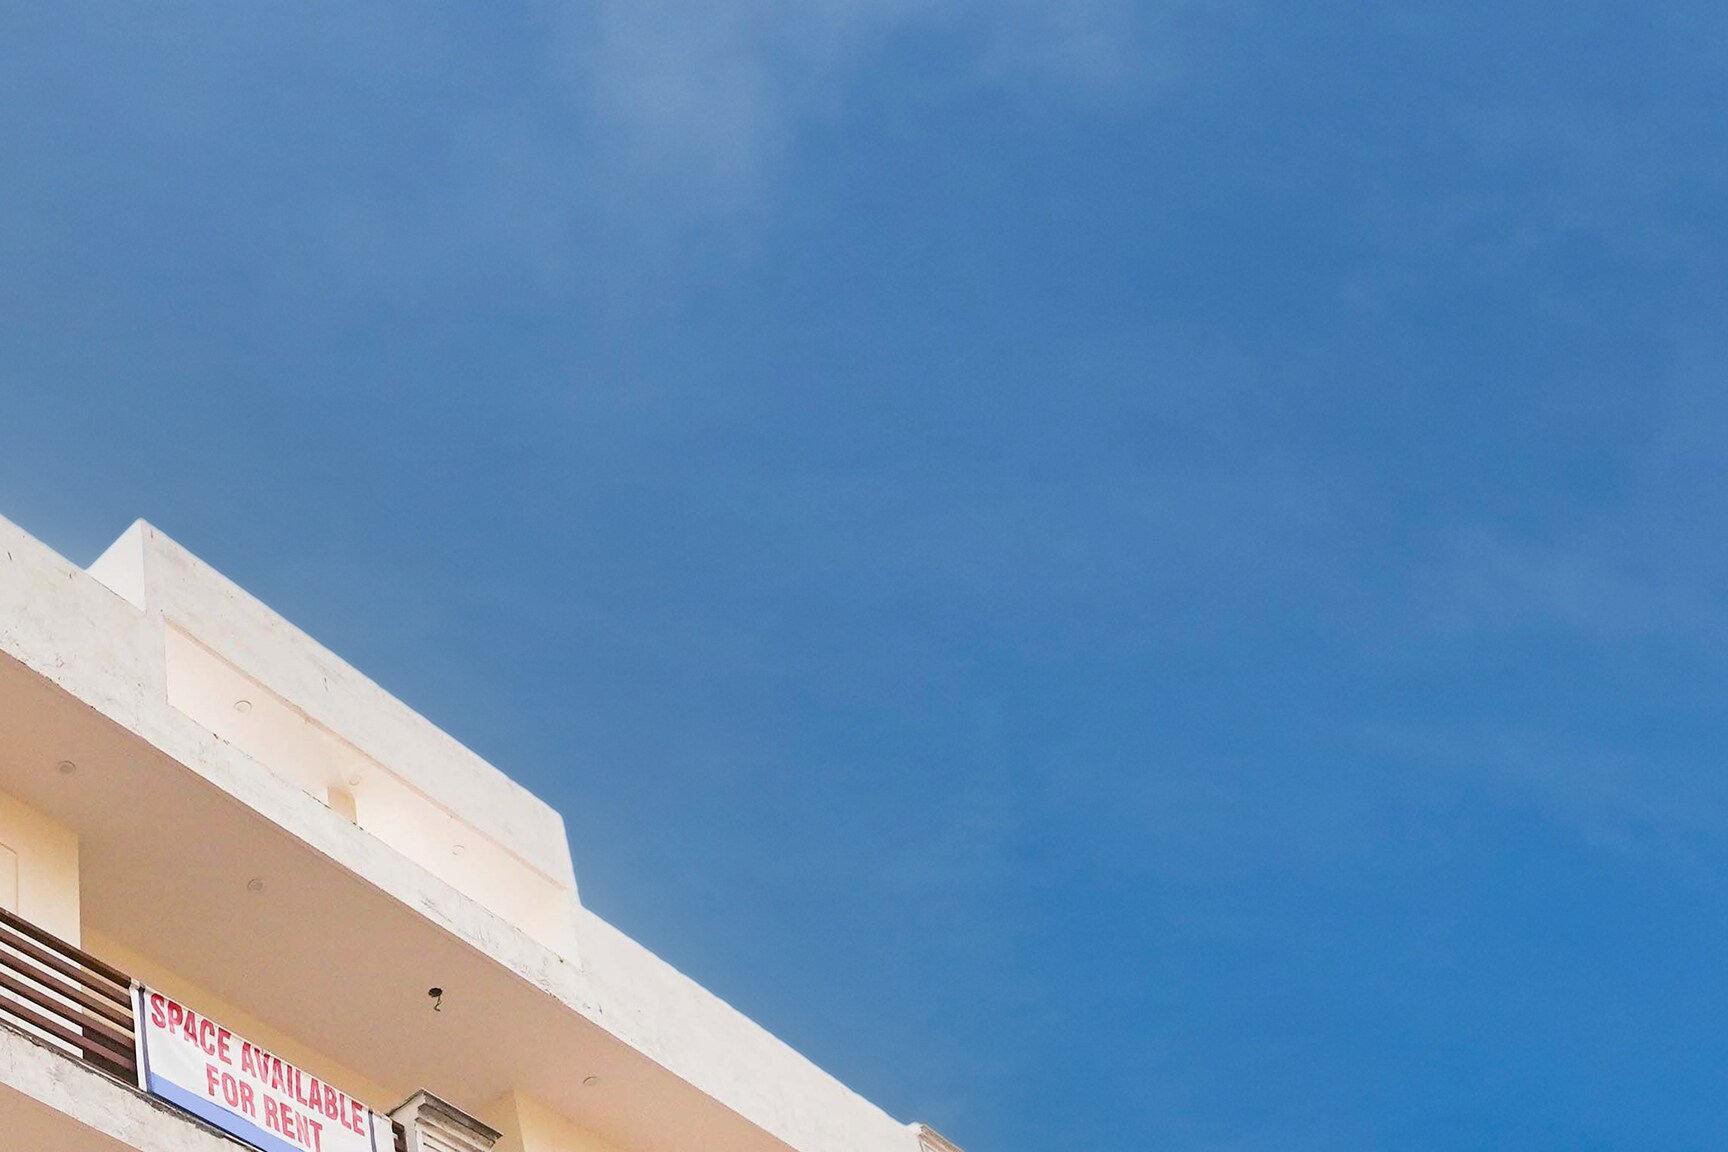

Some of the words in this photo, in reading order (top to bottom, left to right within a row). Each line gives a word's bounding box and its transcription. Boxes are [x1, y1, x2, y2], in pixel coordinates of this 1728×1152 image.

[151, 993, 232, 1065] SPACE
[241, 1041, 365, 1136] AVAILABLE
[206, 1063, 256, 1120] FOR
